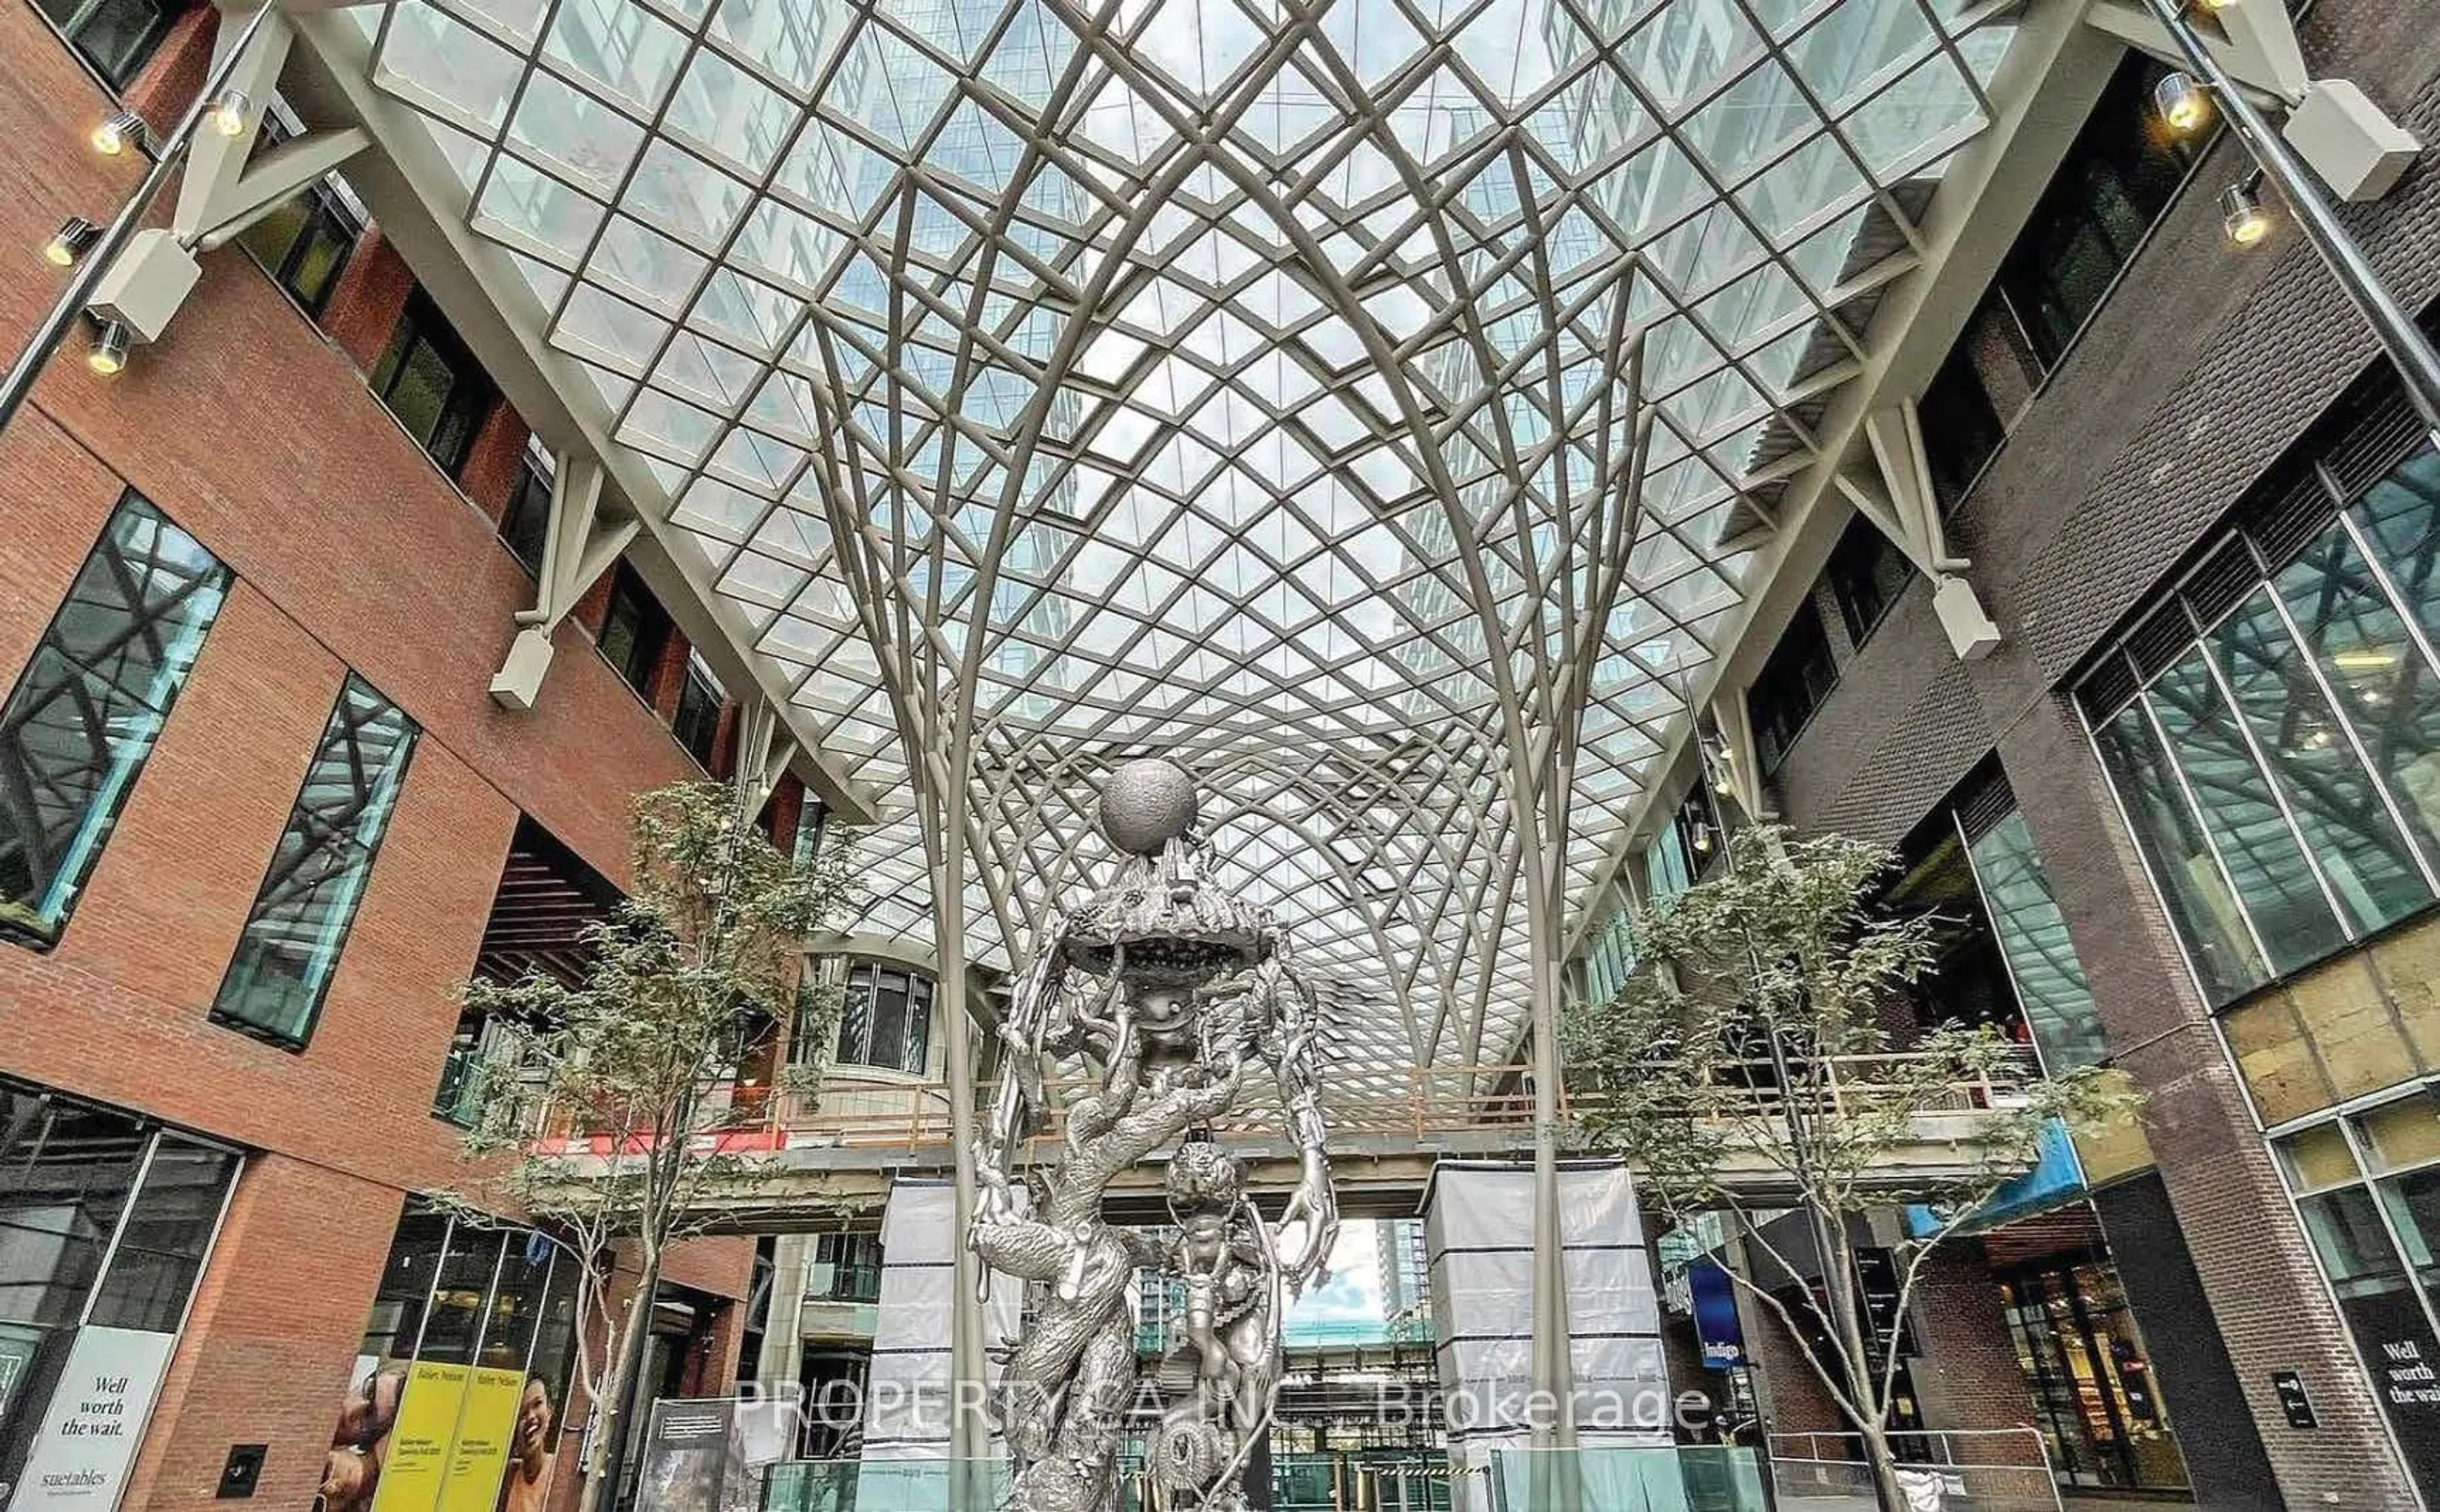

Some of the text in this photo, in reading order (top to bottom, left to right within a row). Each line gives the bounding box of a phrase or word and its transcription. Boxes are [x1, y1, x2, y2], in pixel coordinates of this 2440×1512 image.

[2382, 1340, 2420, 1360] Well
[2389, 1362, 2436, 1381] worth
[95, 1377, 128, 1394] Well
[2390, 1386, 2415, 1403] the
[81, 1399, 123, 1415] worth
[61, 1418, 123, 1436] the wait.
